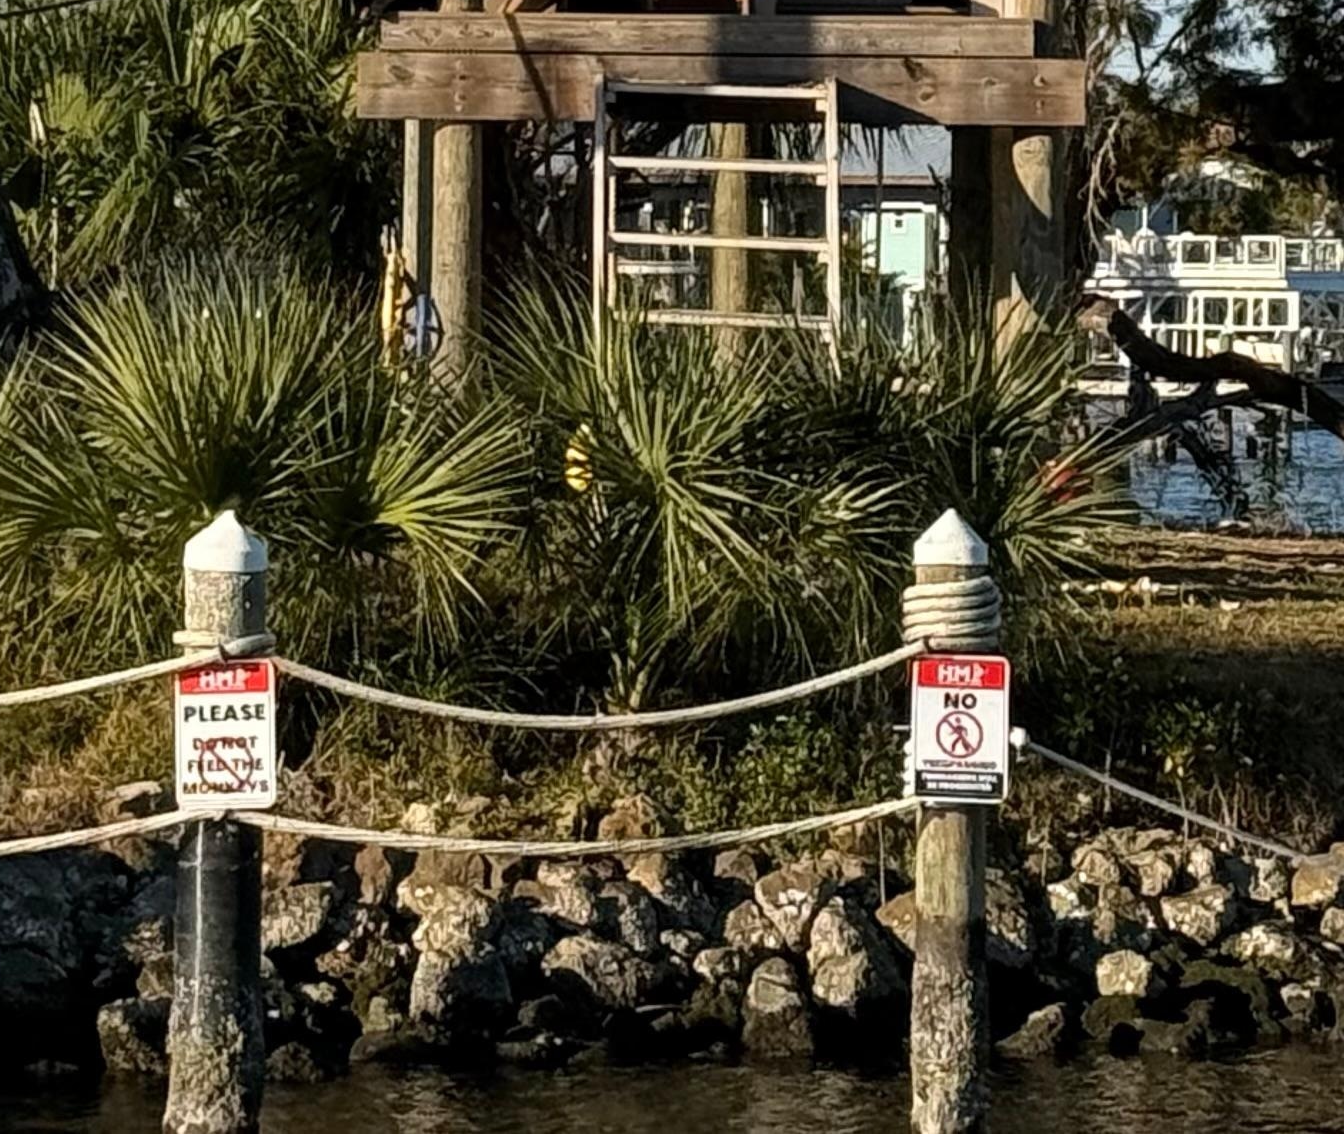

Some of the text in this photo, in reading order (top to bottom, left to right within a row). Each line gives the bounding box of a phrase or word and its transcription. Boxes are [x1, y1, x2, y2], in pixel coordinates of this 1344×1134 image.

[944, 692, 977, 709] NO
[183, 704, 266, 722] PLEASE
[193, 736, 258, 750] DO NOT
[187, 758, 264, 773] FEED THE
